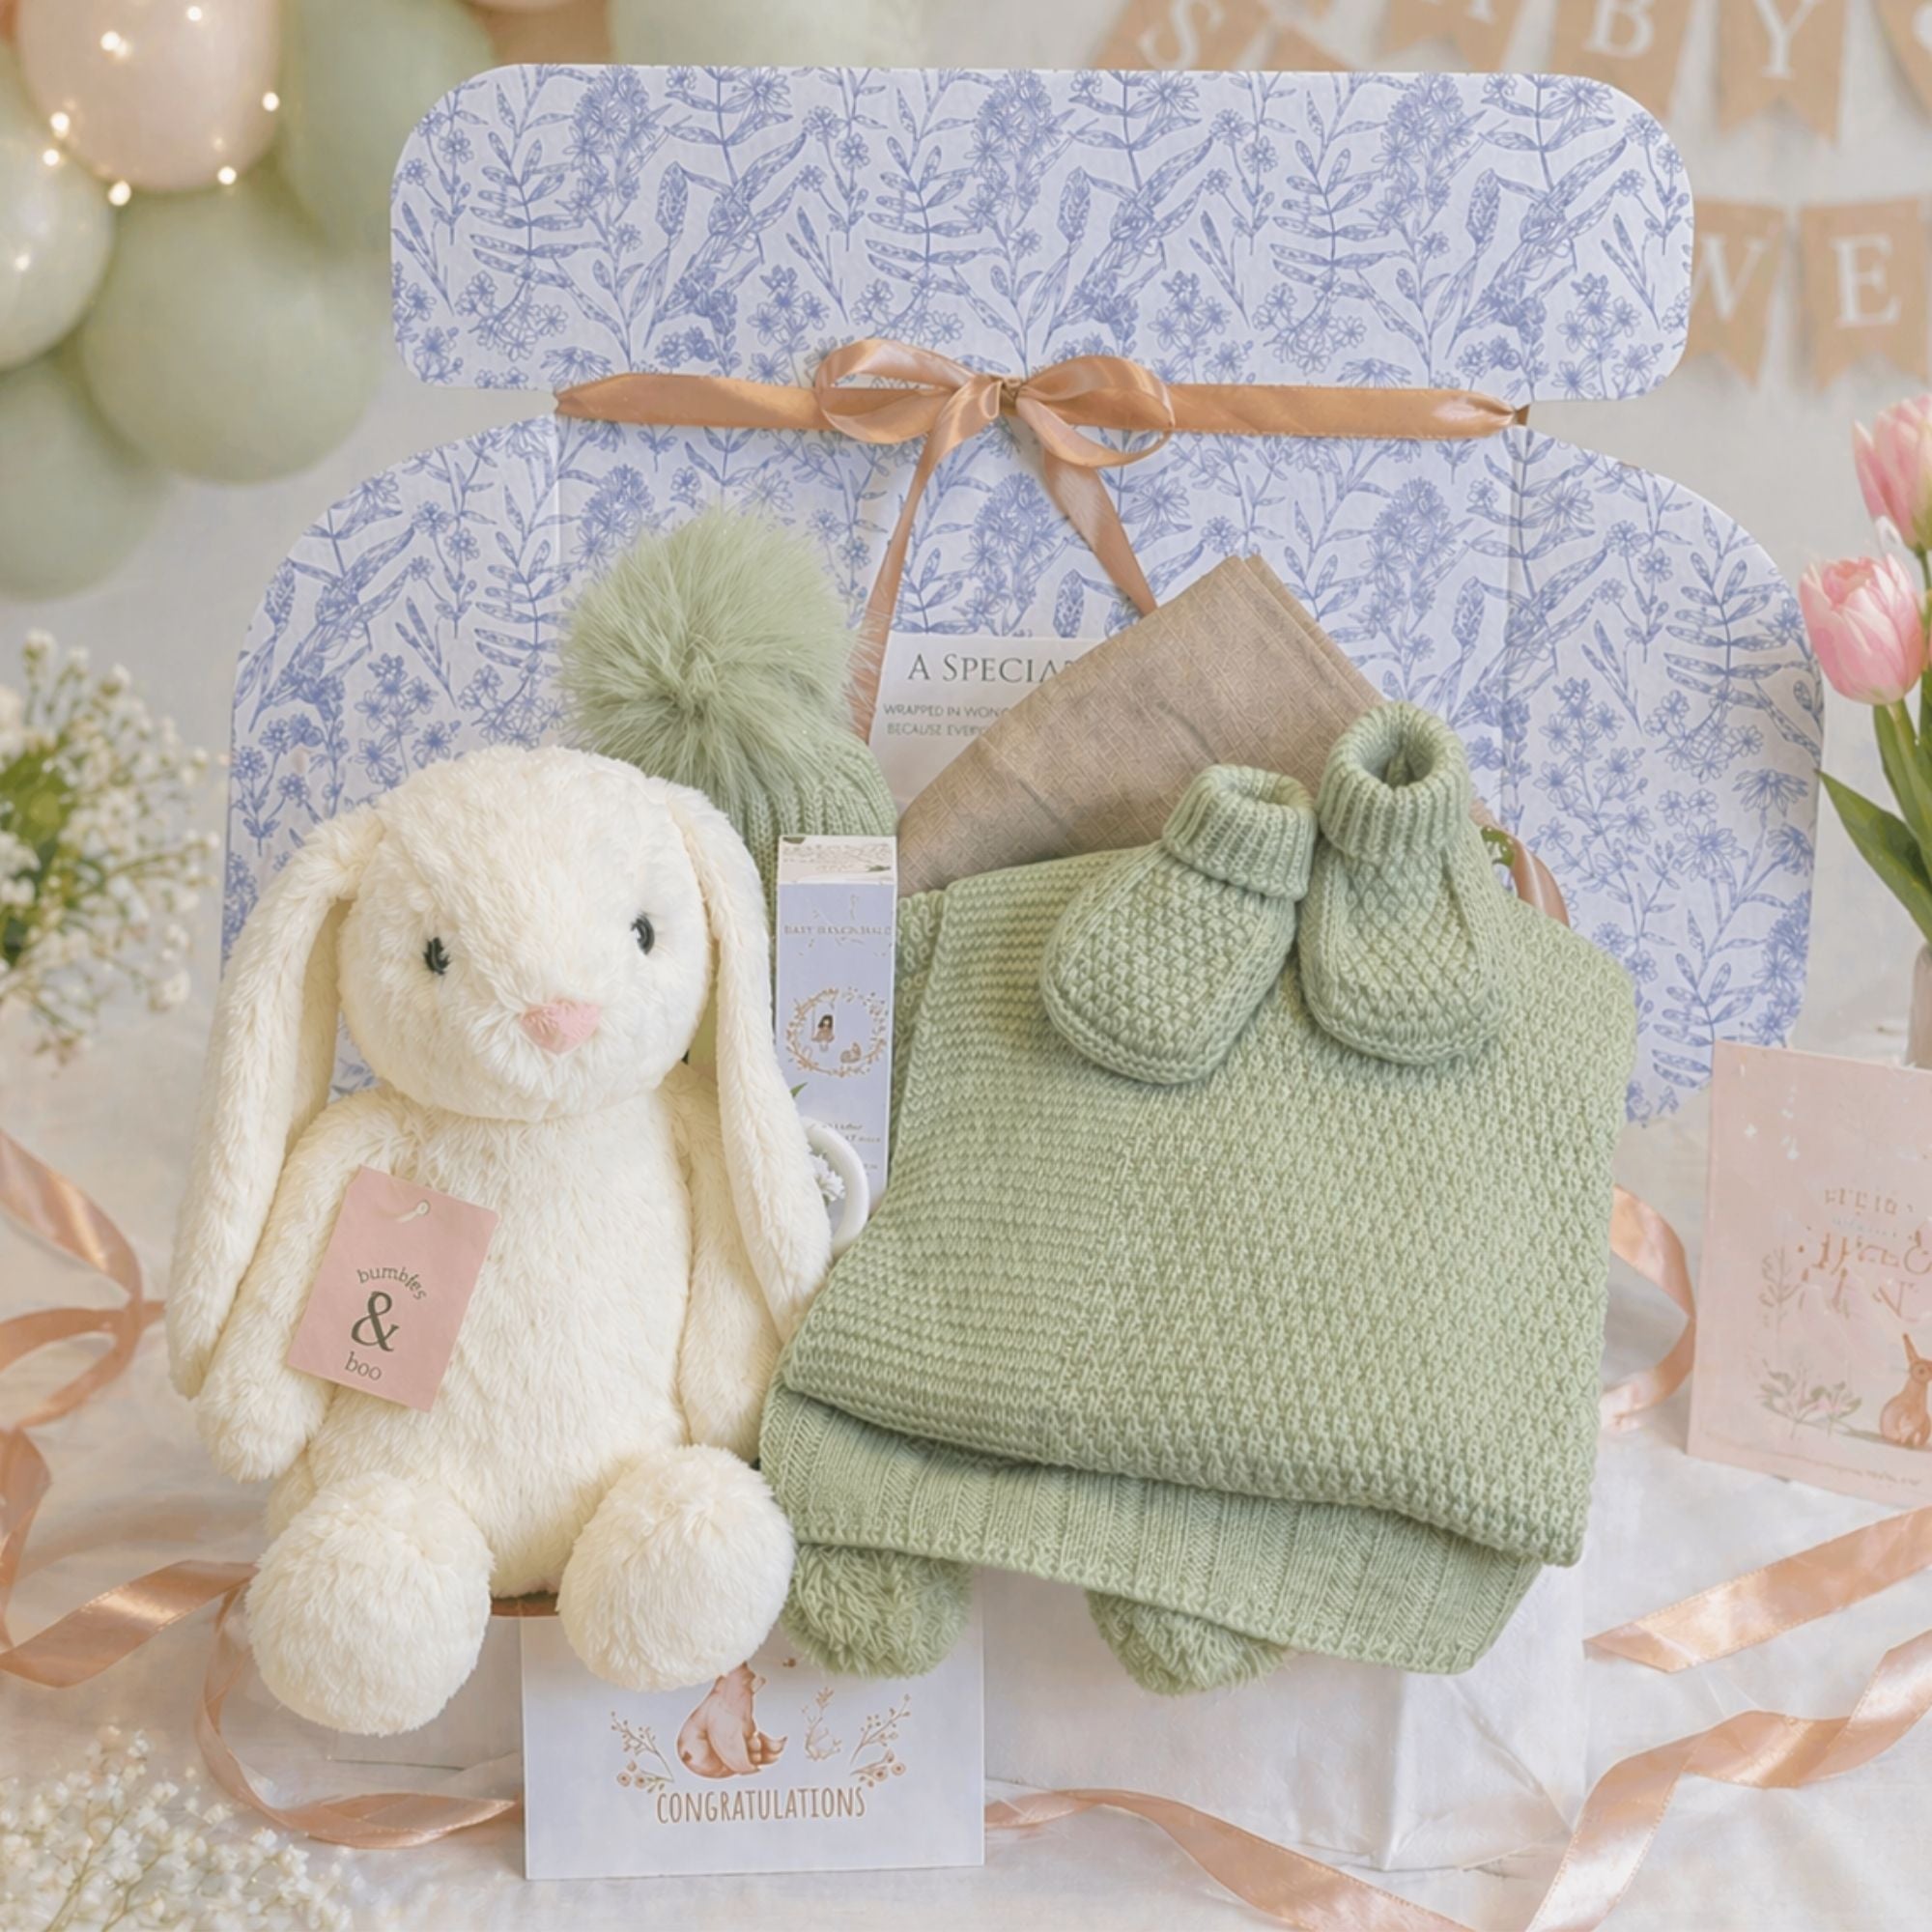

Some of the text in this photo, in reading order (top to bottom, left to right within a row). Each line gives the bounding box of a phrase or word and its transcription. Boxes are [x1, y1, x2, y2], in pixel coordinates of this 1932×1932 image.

[908, 653, 1074, 683] A SPECIA
[883, 703, 1009, 719] WRAPPED IN WON
[887, 723, 942, 735] BECAUSE
[351, 1291, 400, 1351] &
[344, 1350, 383, 1381] boo
[657, 1787, 866, 1824] CONGRATULATIONS
